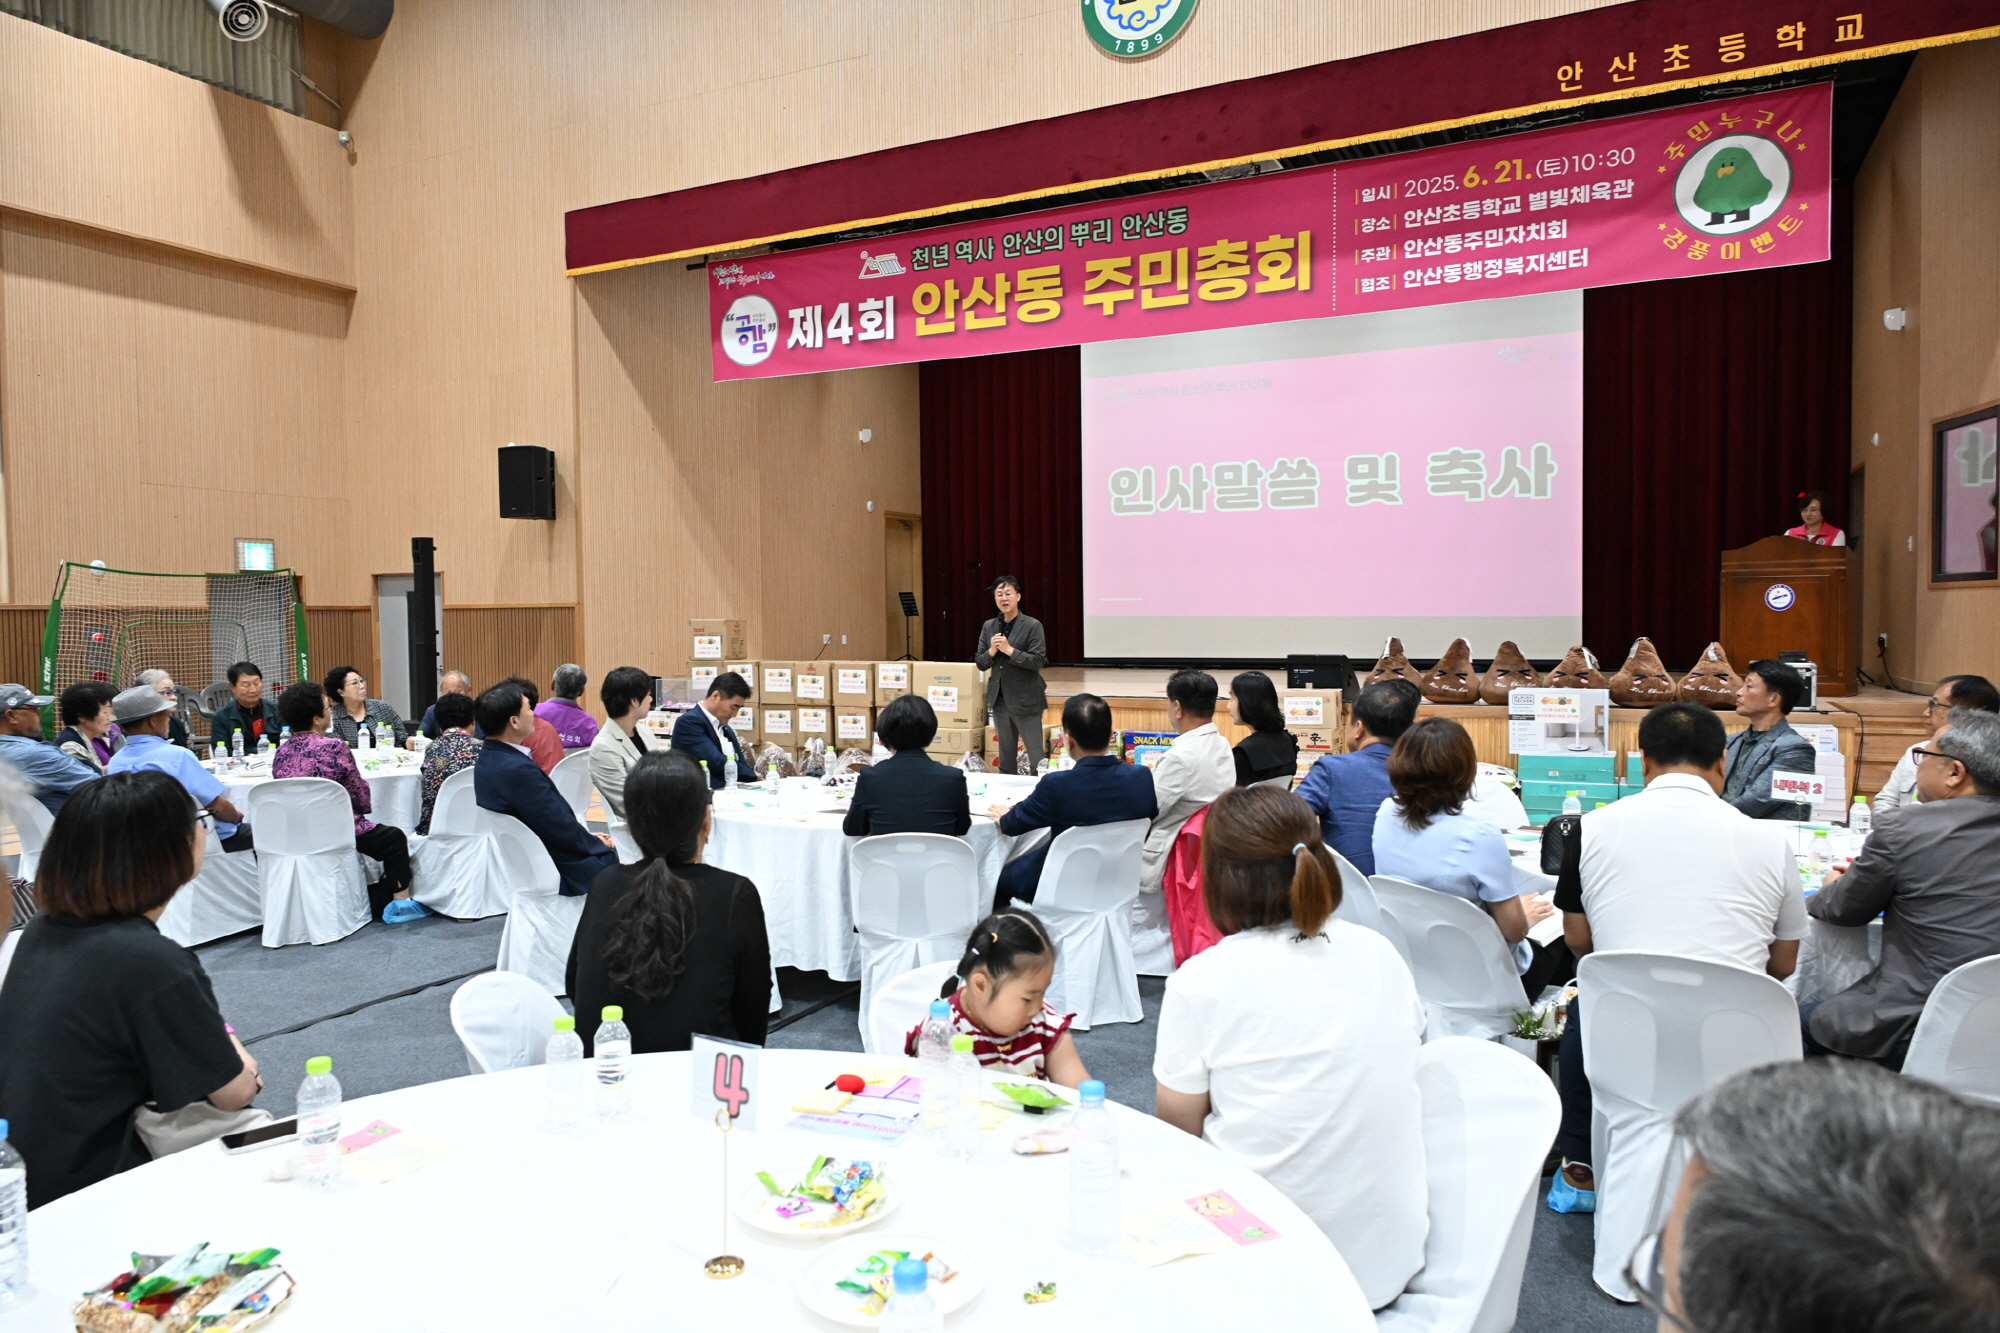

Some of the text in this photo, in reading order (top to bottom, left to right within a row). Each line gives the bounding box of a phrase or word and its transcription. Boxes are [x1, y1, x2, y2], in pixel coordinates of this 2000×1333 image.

[1115, 33, 1164, 53] 1899
[1556, 13, 1864, 92] 안산초등학교
[1361, 185, 1391, 202] 일시
[1404, 175, 1460, 198] 2025.
[1361, 178, 1634, 233] 장소 안산초등학교 별빛체육관
[911, 206, 1189, 271] 천년 역사 안산의 뿌리 안산동
[1361, 219, 1568, 263] 주관 안산동주민자치회
[787, 229, 1311, 348] 제4회 안산동 주민총회
[1361, 248, 1589, 293] 협조 안산동행정복지센터
[1110, 442, 1559, 516] 인사말씀 및 축사
[1133, 736, 1158, 745] SNACK
[1774, 779, 1823, 794] 내빈석 2
[713, 1052, 749, 1119] 4
